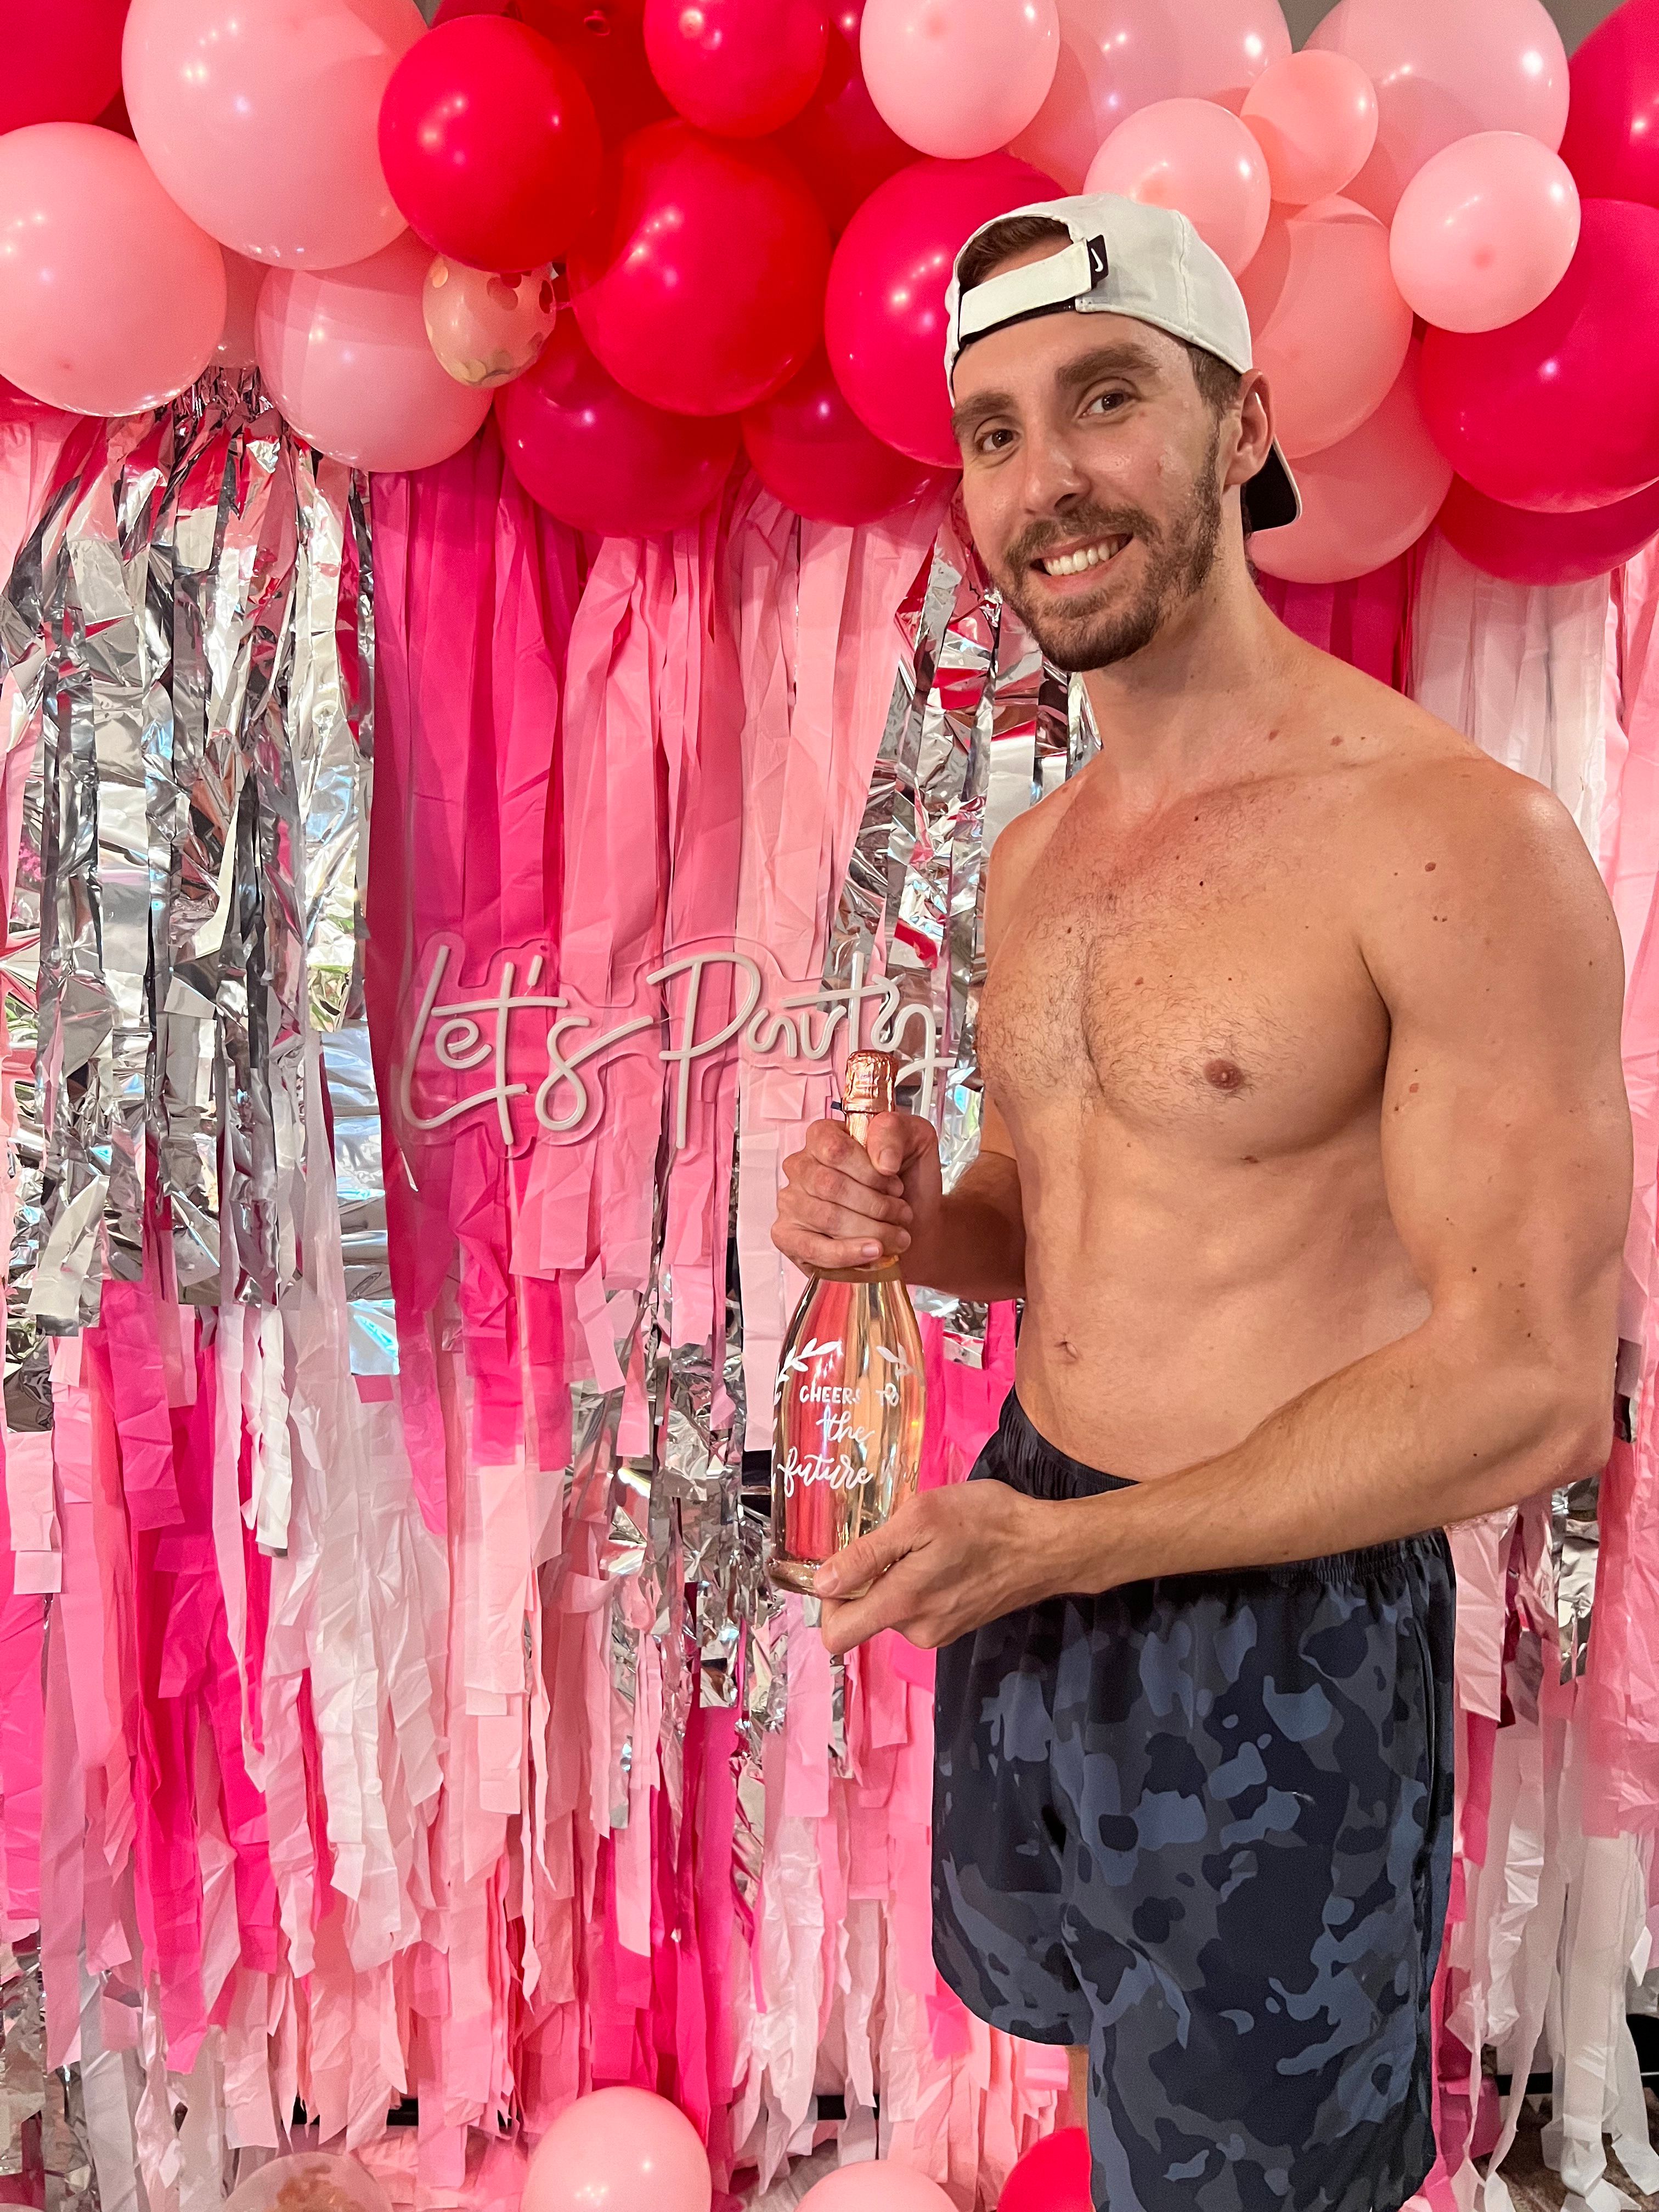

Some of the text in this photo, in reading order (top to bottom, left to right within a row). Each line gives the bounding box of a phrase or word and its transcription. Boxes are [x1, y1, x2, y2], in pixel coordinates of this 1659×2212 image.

[401, 945, 653, 1145] Let's
[799, 1385, 860, 1404] CHEERS
[816, 1410, 875, 1443] the
[777, 1446, 874, 1498] future
